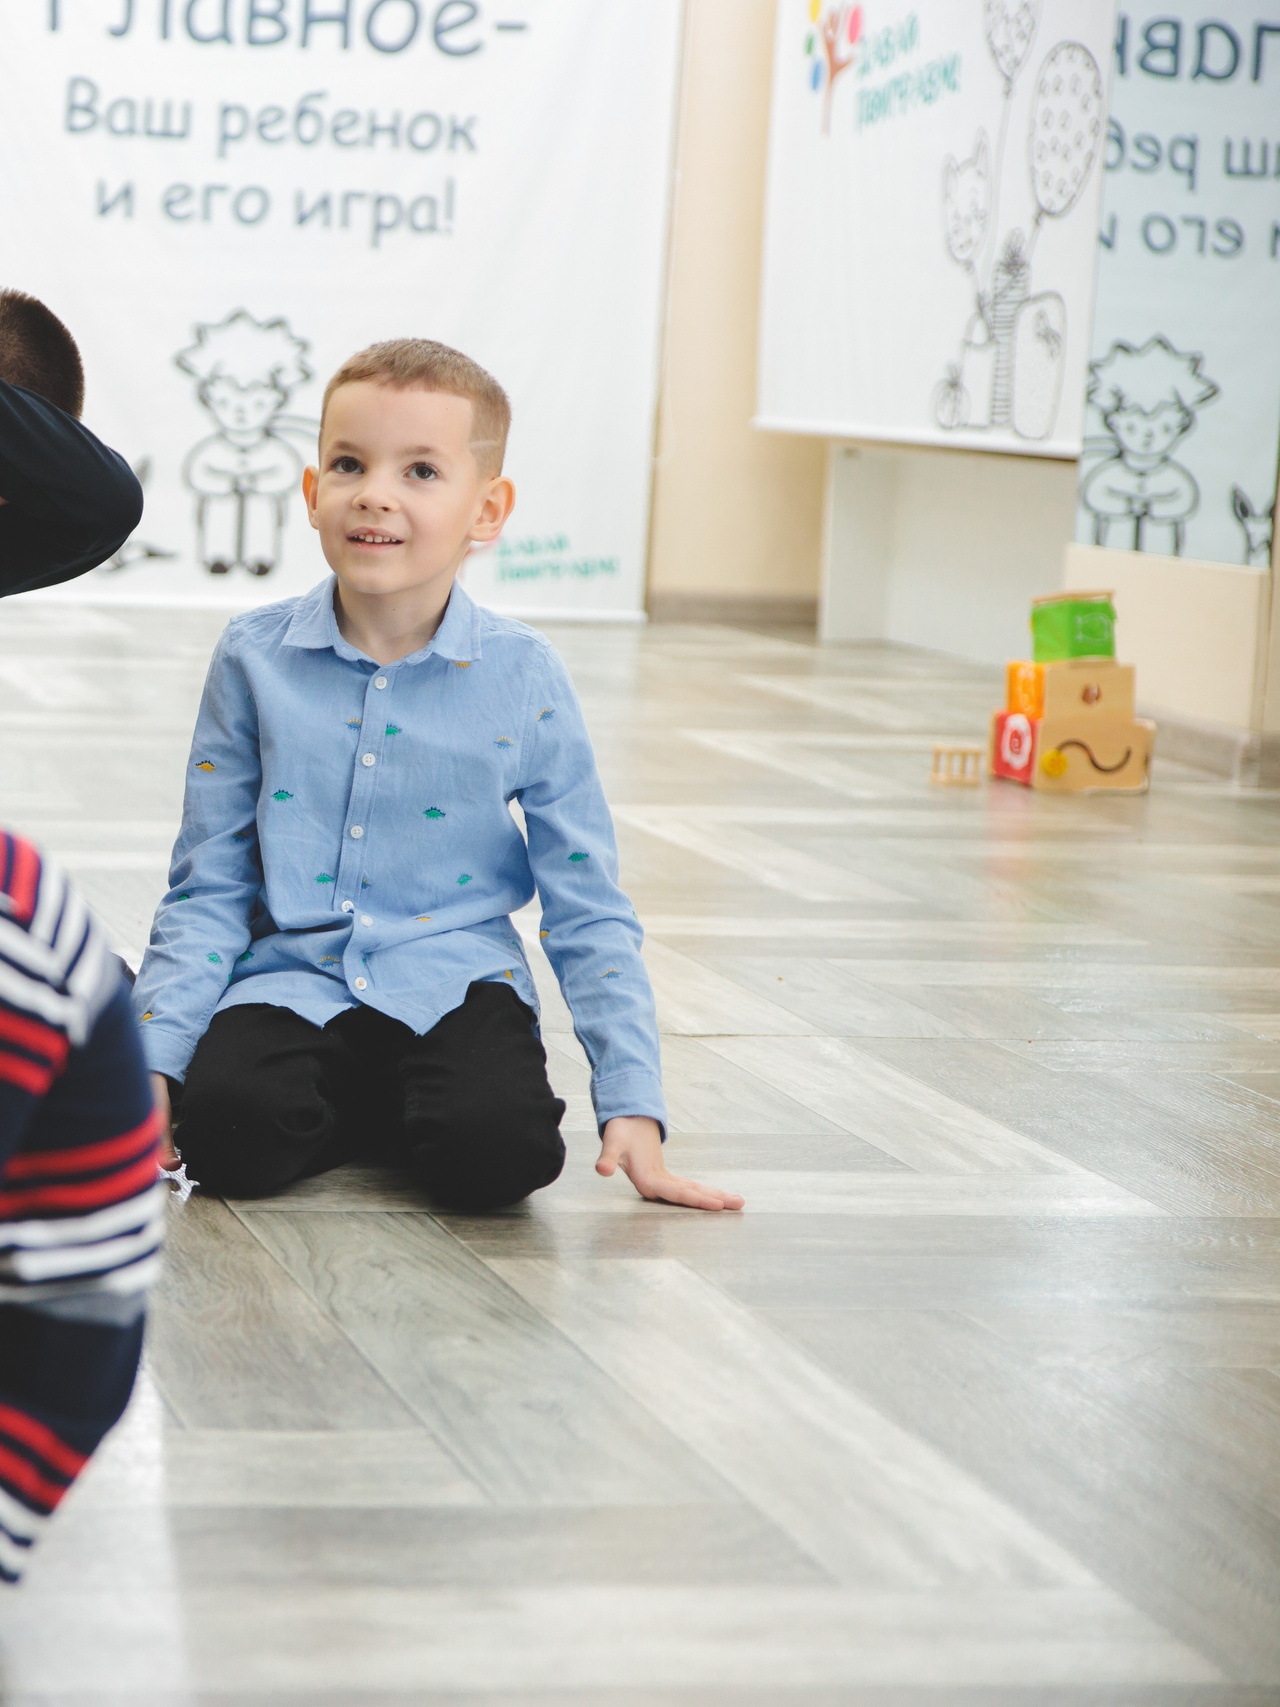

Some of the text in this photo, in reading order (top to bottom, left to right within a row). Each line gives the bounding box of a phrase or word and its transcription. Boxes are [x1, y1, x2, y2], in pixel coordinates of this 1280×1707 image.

[64, 77, 479, 157] Ваш ребенок
[96, 178, 458, 248] и его игра!
